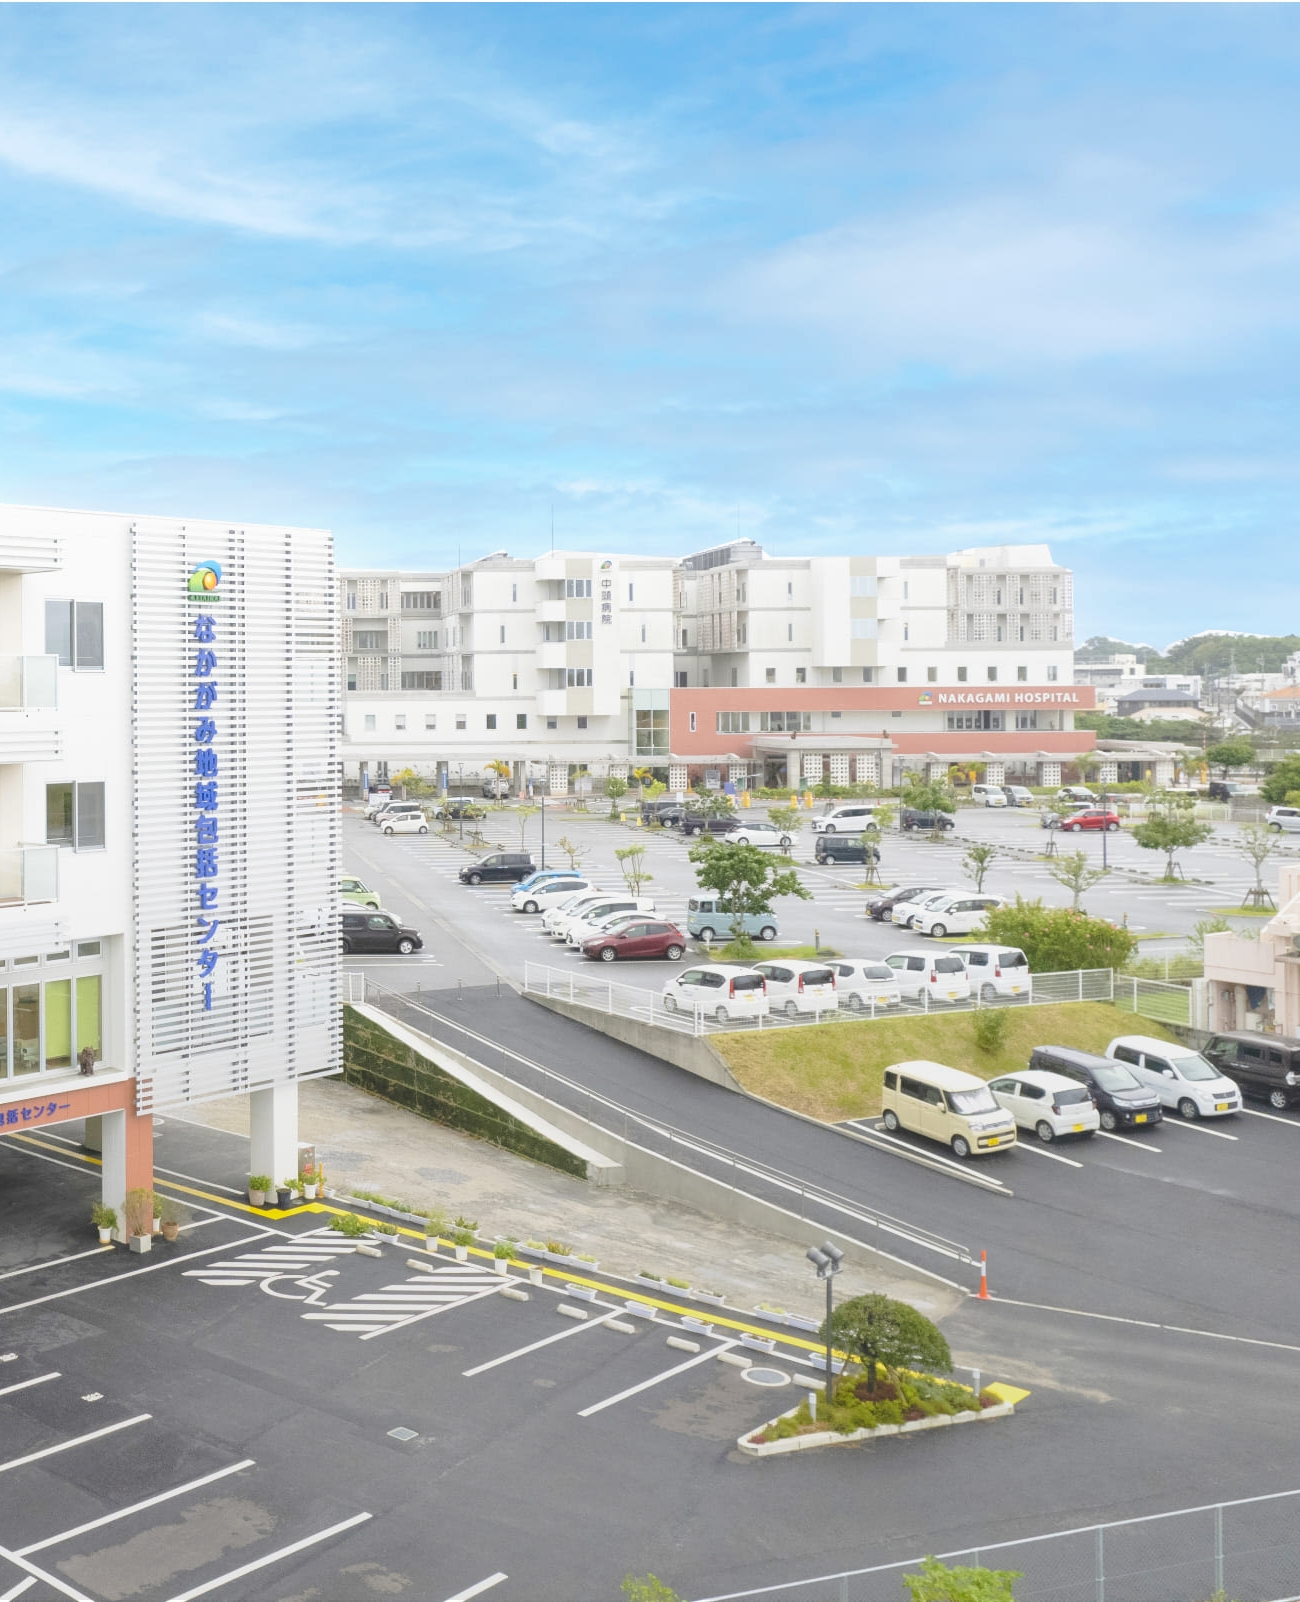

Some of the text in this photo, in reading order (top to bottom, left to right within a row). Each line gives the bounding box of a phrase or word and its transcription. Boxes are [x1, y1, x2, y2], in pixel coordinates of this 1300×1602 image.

[601, 578, 612, 625] 中頭病院
[938, 692, 1079, 704] NAKAGAMI HOSPITAL
[194, 614, 219, 1010] なかがみ地域包括センター
